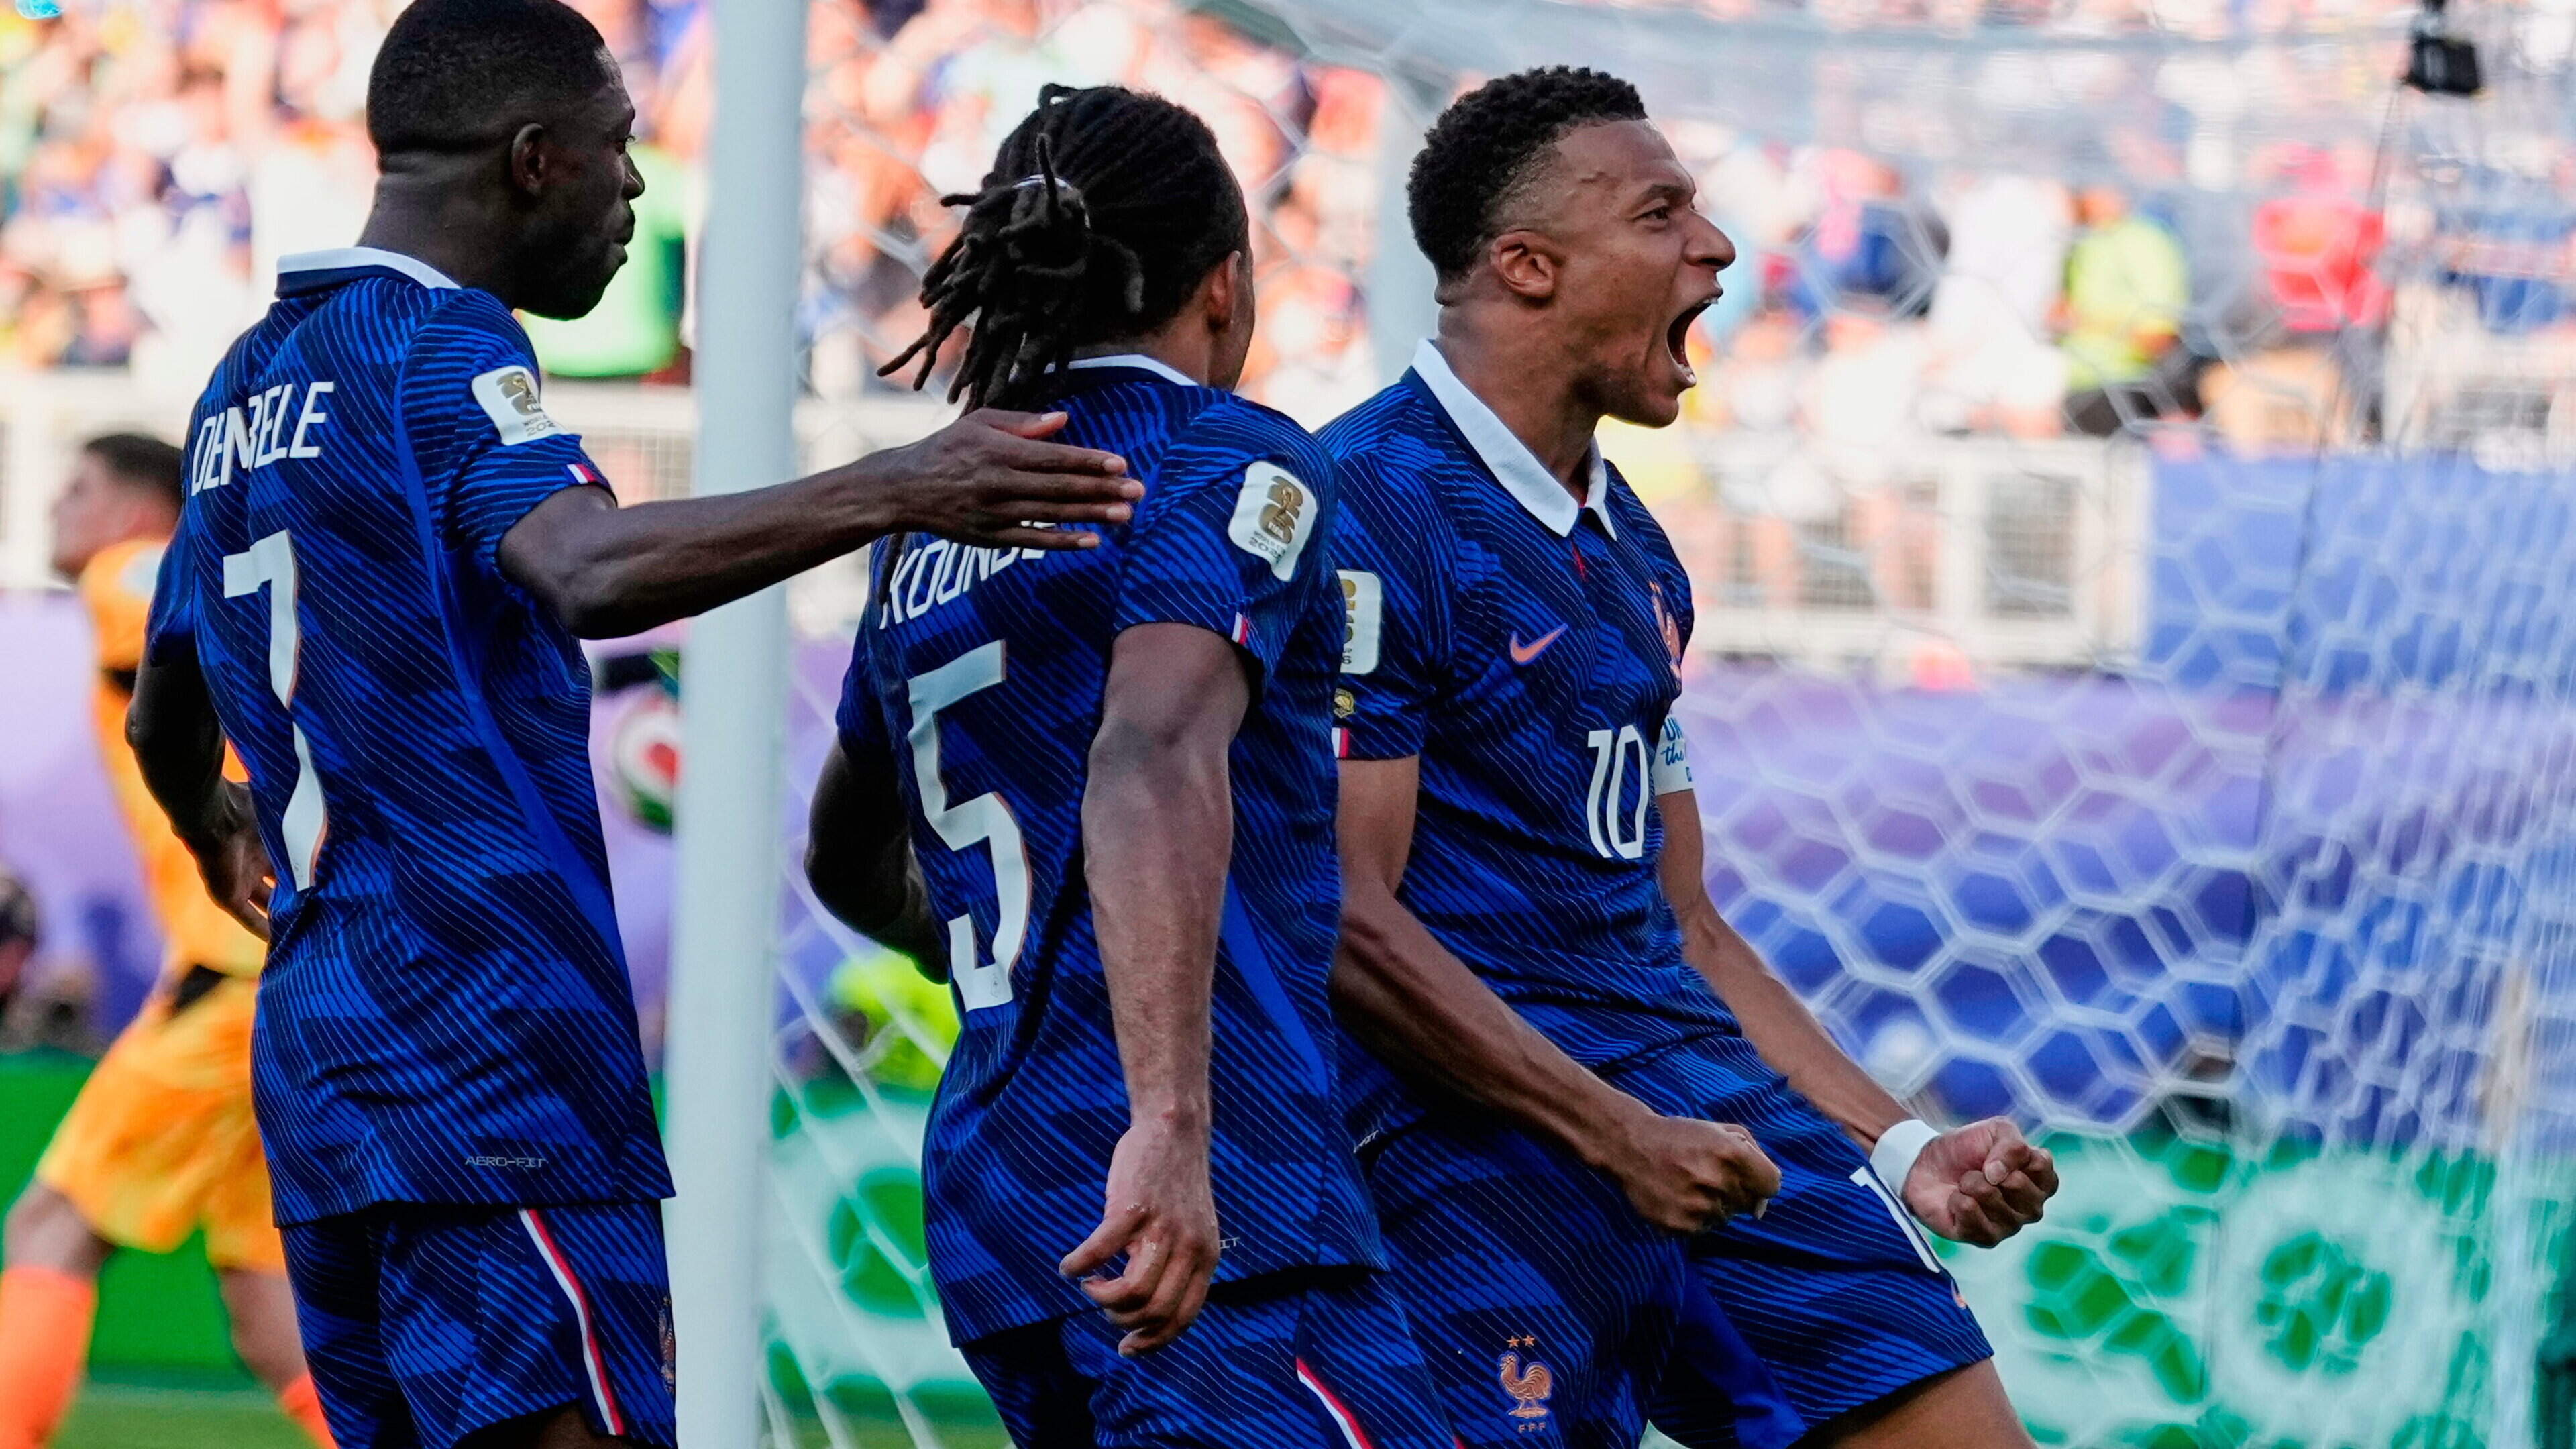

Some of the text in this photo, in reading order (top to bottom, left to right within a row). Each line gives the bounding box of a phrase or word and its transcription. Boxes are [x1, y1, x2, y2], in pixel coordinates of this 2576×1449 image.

[223, 529, 328, 891] 7
[907, 639, 1032, 1012] 5
[1587, 725, 1647, 858] 10
[465, 1155, 549, 1168] AERO-FIT
[1849, 1166, 1941, 1273] 1
